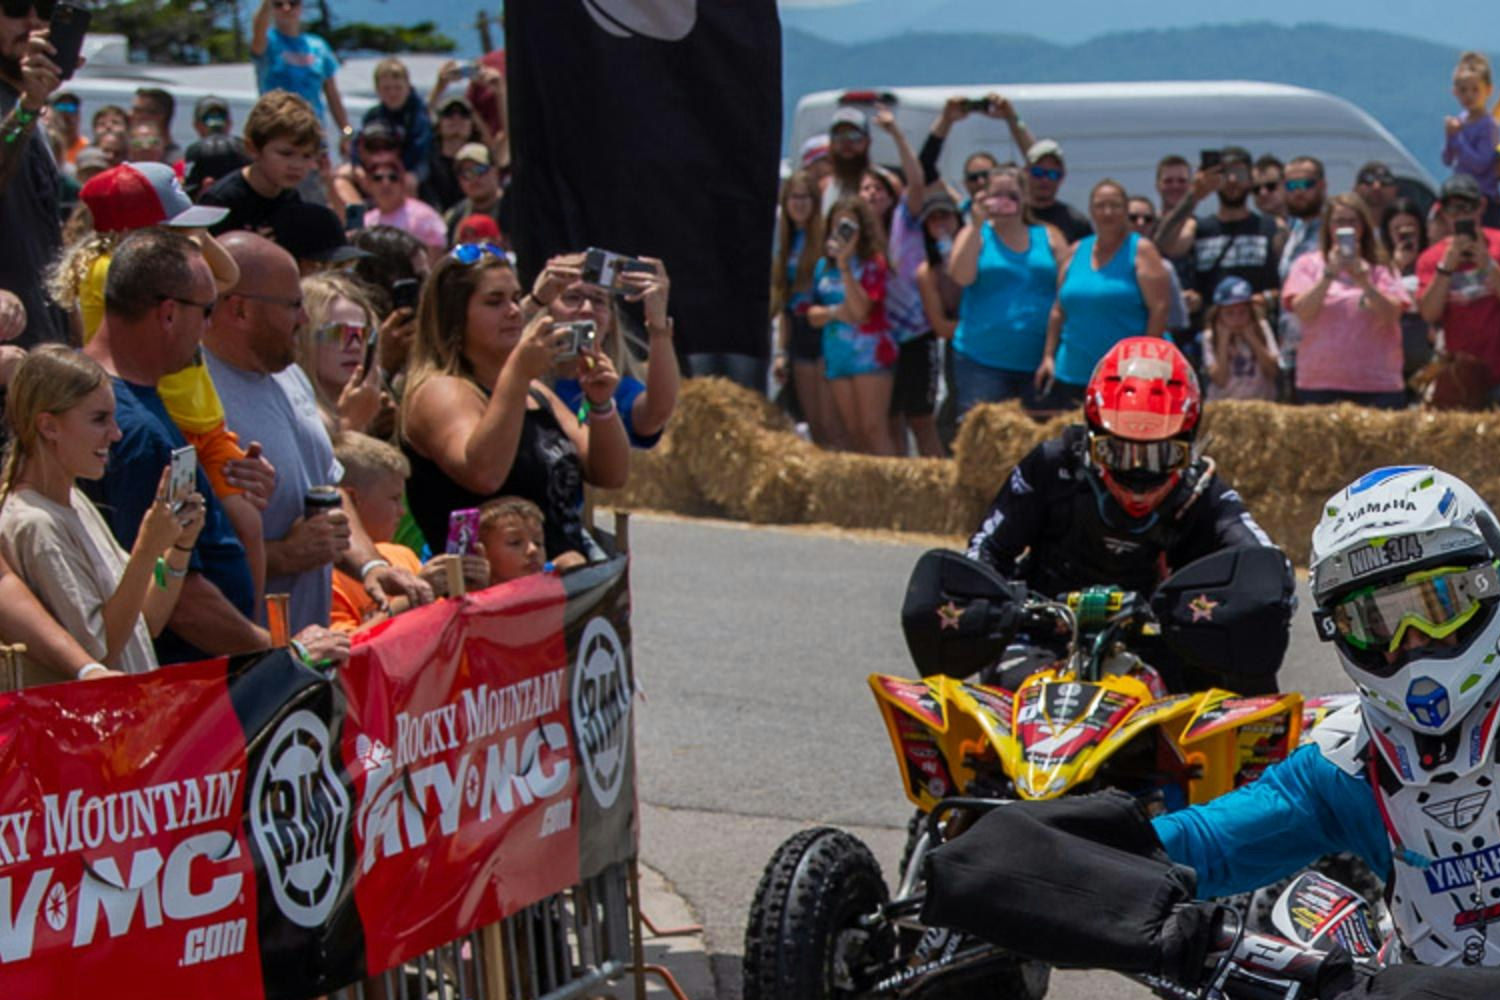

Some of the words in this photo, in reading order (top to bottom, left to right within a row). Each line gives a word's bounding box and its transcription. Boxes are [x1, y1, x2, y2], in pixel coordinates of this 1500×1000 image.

[1347, 499, 1418, 523] YAMAHA
[1350, 546, 1391, 577] NINE
[1389, 532, 1422, 566] 3/4
[396, 703, 460, 769] ROCKY
[463, 668, 566, 743] MOUNTAIN
[42, 769, 241, 858] MOUNTAIN
